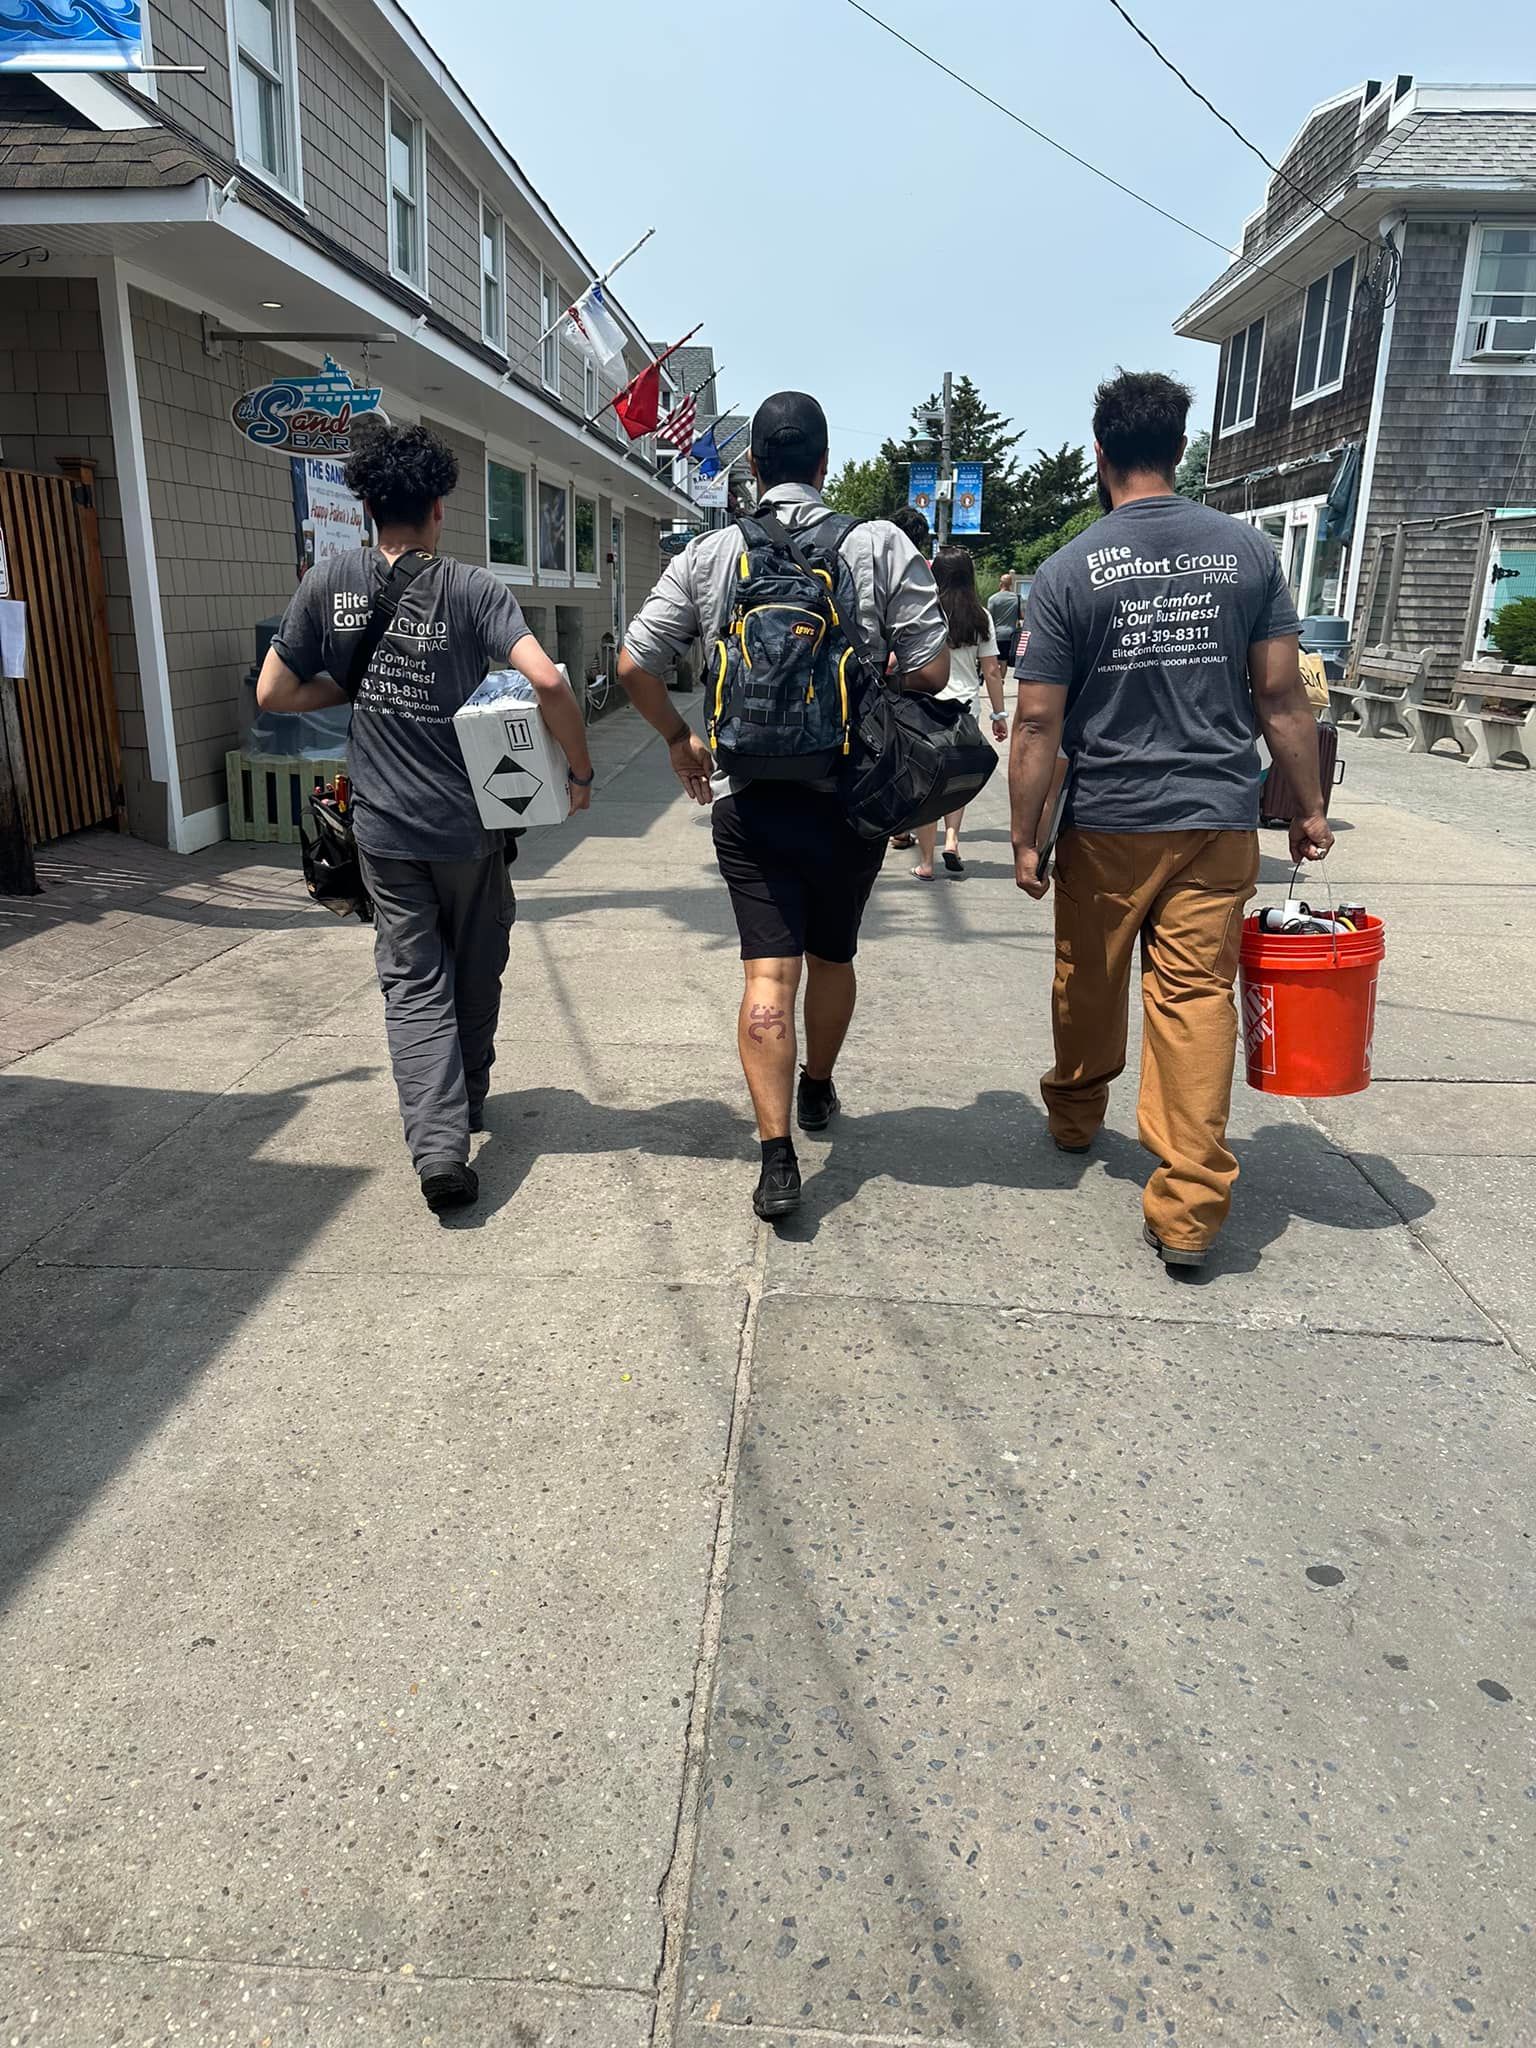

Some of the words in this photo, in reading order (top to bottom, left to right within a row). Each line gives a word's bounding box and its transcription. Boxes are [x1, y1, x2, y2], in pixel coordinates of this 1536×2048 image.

[247, 386, 351, 446] Sand
[292, 432, 352, 452] BAR
[307, 460, 324, 481] THE
[1086, 546, 1132, 570] Elite
[1090, 557, 1171, 585] Comfort
[1175, 553, 1238, 570] Group
[1203, 572, 1239, 585] HVAC
[333, 591, 369, 610] Elite
[1120, 599, 1151, 614] Your
[1153, 592, 1213, 608] Comfort
[397, 617, 447, 636] Group
[1112, 616, 1124, 629] Is
[1127, 612, 1154, 627] Our
[1156, 605, 1220, 623] Business!
[418, 639, 449, 653] HVAC
[1121, 626, 1210, 647] 631-319-8311
[378, 650, 427, 671] Comfort
[379, 662, 435, 684] Business!
